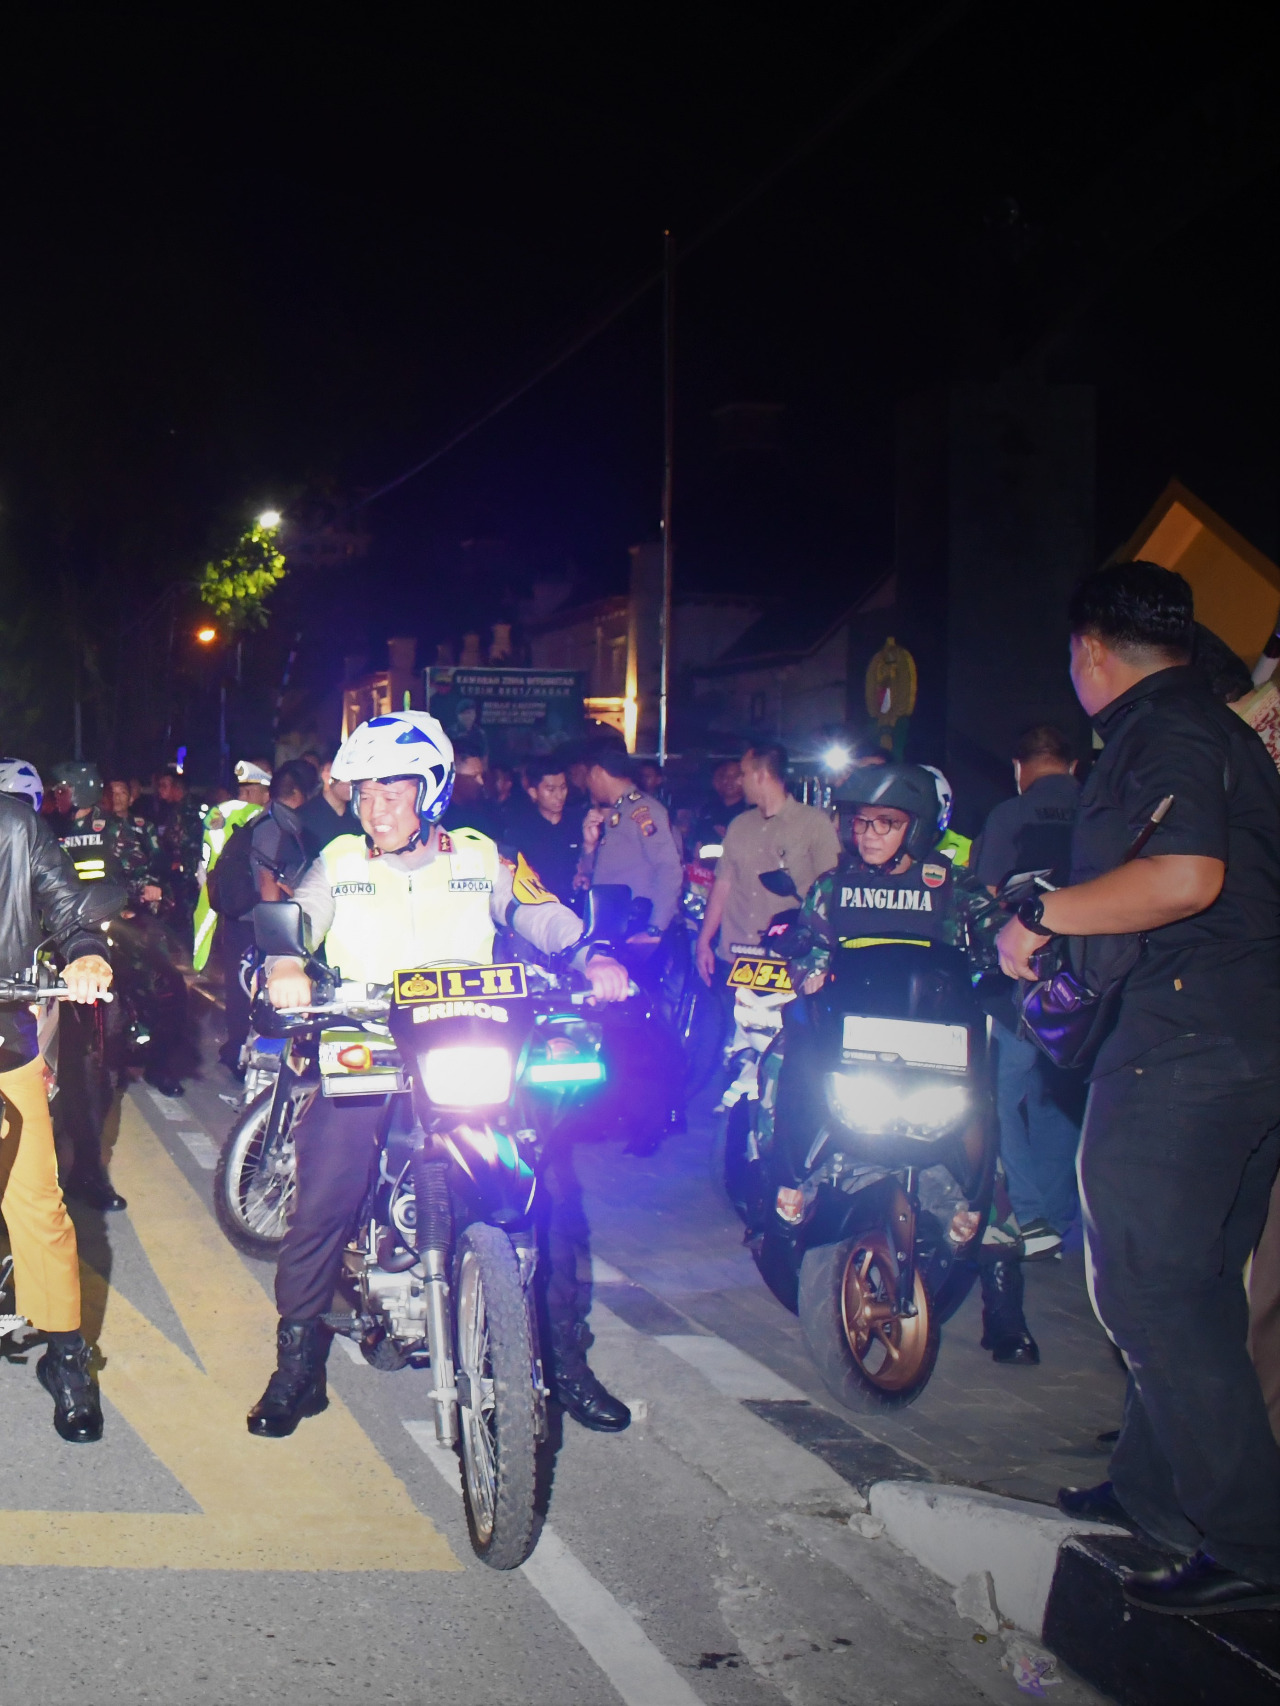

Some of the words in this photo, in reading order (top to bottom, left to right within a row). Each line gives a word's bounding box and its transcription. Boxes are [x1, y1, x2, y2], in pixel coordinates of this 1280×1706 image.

[333, 883, 373, 895] AGUNG
[450, 881, 490, 891] KAPOLDA
[839, 887, 933, 912] PANGLIMA
[412, 1001, 509, 1024] BRIMOB
